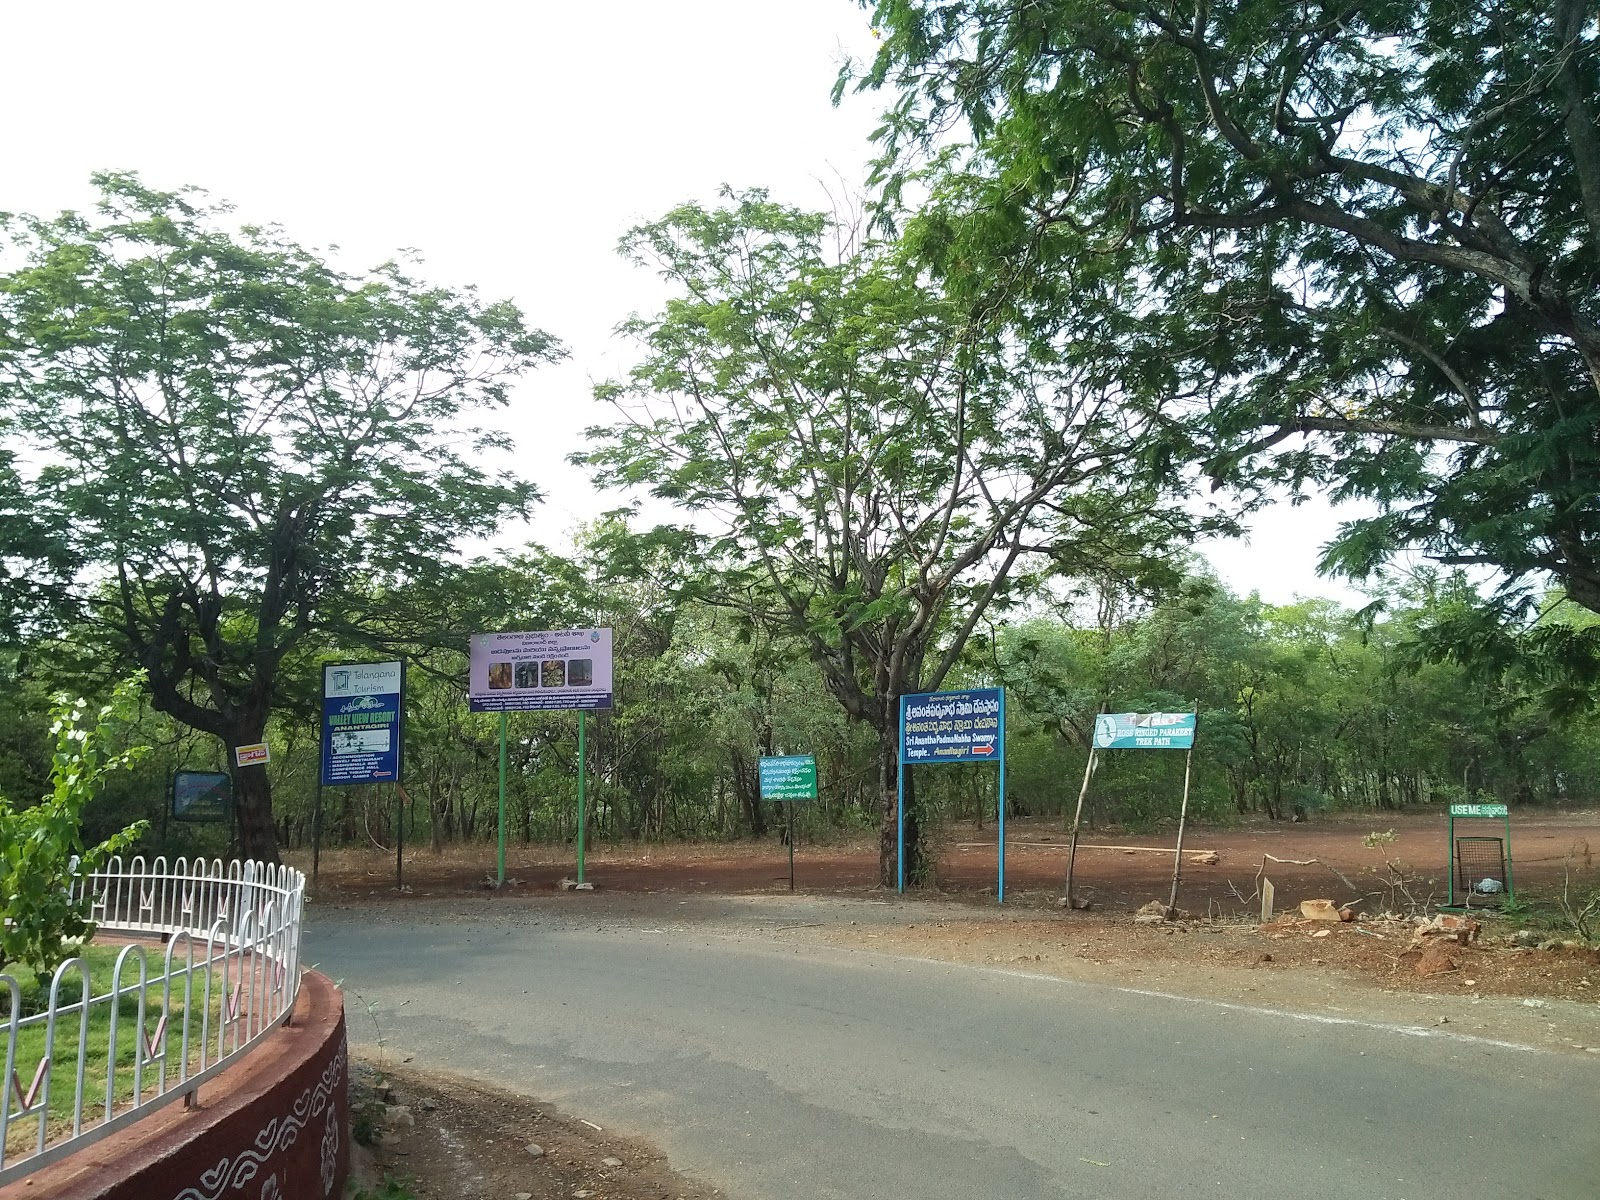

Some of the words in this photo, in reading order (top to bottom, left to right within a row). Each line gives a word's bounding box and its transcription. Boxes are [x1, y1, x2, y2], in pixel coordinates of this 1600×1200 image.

[353, 669, 396, 682] Telangana
[354, 684, 385, 693] Tourism
[329, 714, 351, 726] VALLEY
[352, 712, 369, 724] VIEW
[370, 711, 395, 723] RESORT
[334, 723, 389, 732] ANANTAGIRI
[1117, 729, 1134, 737] ROSE
[1134, 728, 1158, 737] RINGED
[1159, 727, 1193, 736] PARAKEET
[1135, 737, 1153, 745] TREK
[1154, 737, 1171, 745] PATH
[1451, 805, 1467, 815] USE
[1468, 805, 1481, 815] ME
